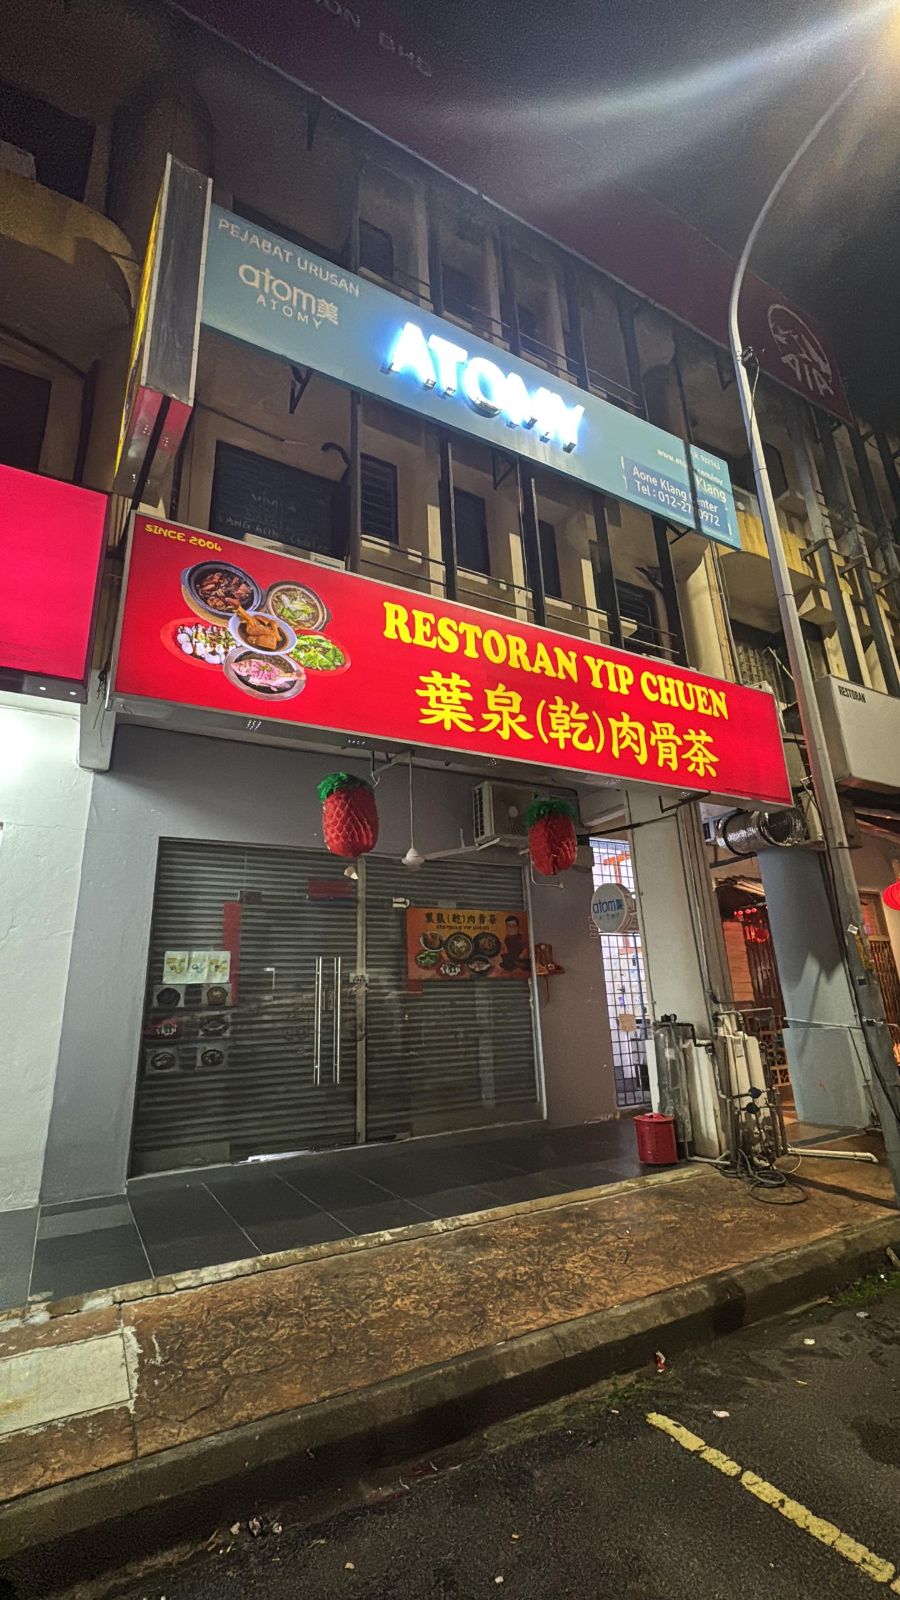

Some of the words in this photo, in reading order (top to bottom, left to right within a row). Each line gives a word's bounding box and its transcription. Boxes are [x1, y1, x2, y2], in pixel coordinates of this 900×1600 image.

[218, 217, 293, 264] PEJABAT
[297, 256, 360, 297] URUSAN
[256, 294, 322, 329] ATOMY
[632, 465, 658, 486] Aone
[659, 477, 687, 502] Klang
[693, 472, 727, 503] Klang
[658, 490, 721, 527] 012-270972
[144, 523, 186, 542] SINCE
[189, 536, 223, 552] 2004
[382, 602, 579, 683] RESTORAN
[583, 655, 635, 695] YIP
[640, 671, 729, 720] CHUEN
[415, 670, 720, 778] 葉泉(乾)肉骨茶
